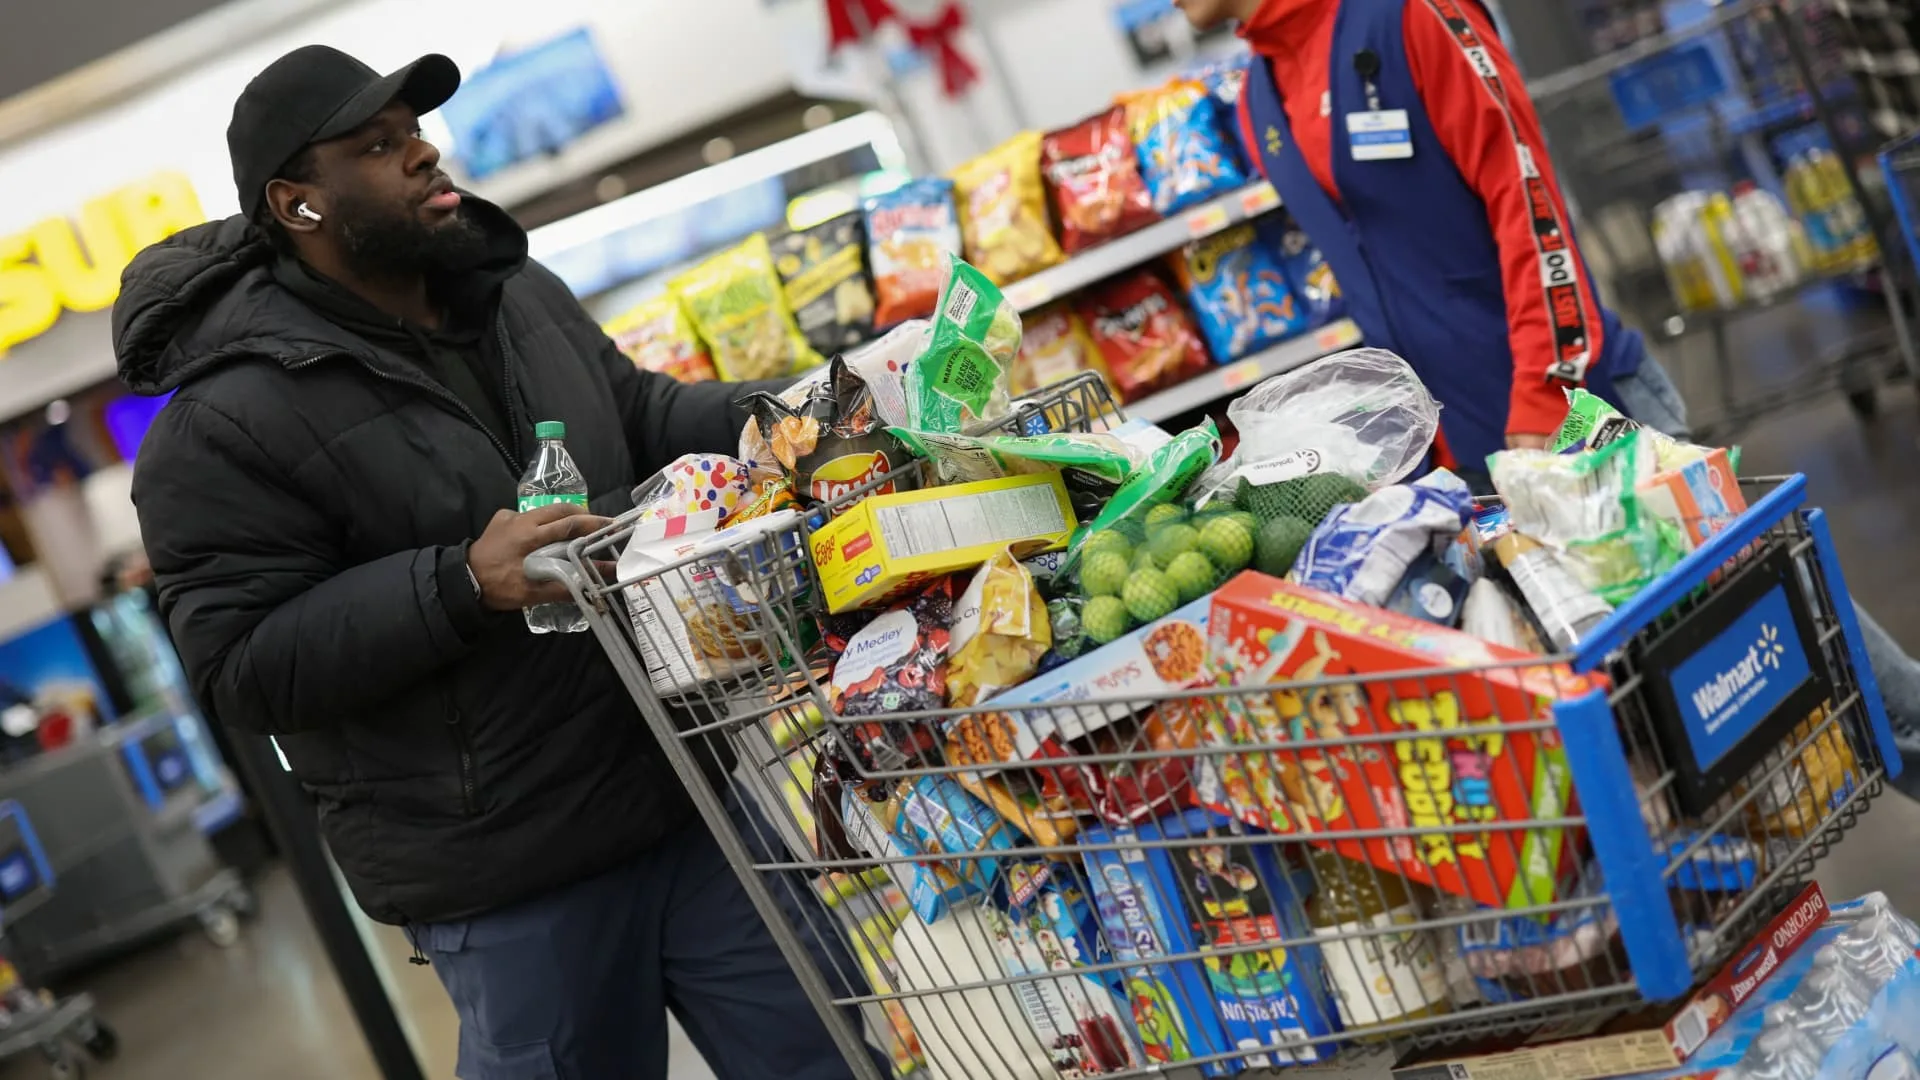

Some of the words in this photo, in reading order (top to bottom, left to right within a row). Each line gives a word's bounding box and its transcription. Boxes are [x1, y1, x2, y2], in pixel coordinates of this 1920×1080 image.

[1546, 253, 1568, 283] DO
[1551, 286, 1581, 328] JUST
[954, 356, 970, 385] CLASSIC
[819, 459, 884, 515] Lay's
[814, 534, 836, 568] Eggo
[856, 625, 904, 654] Medley
[1691, 645, 1764, 720] Walmart
[1771, 891, 1823, 948] DIGIORNO
[1752, 946, 1778, 980] RISING
[1728, 974, 1756, 1003] CRUST
